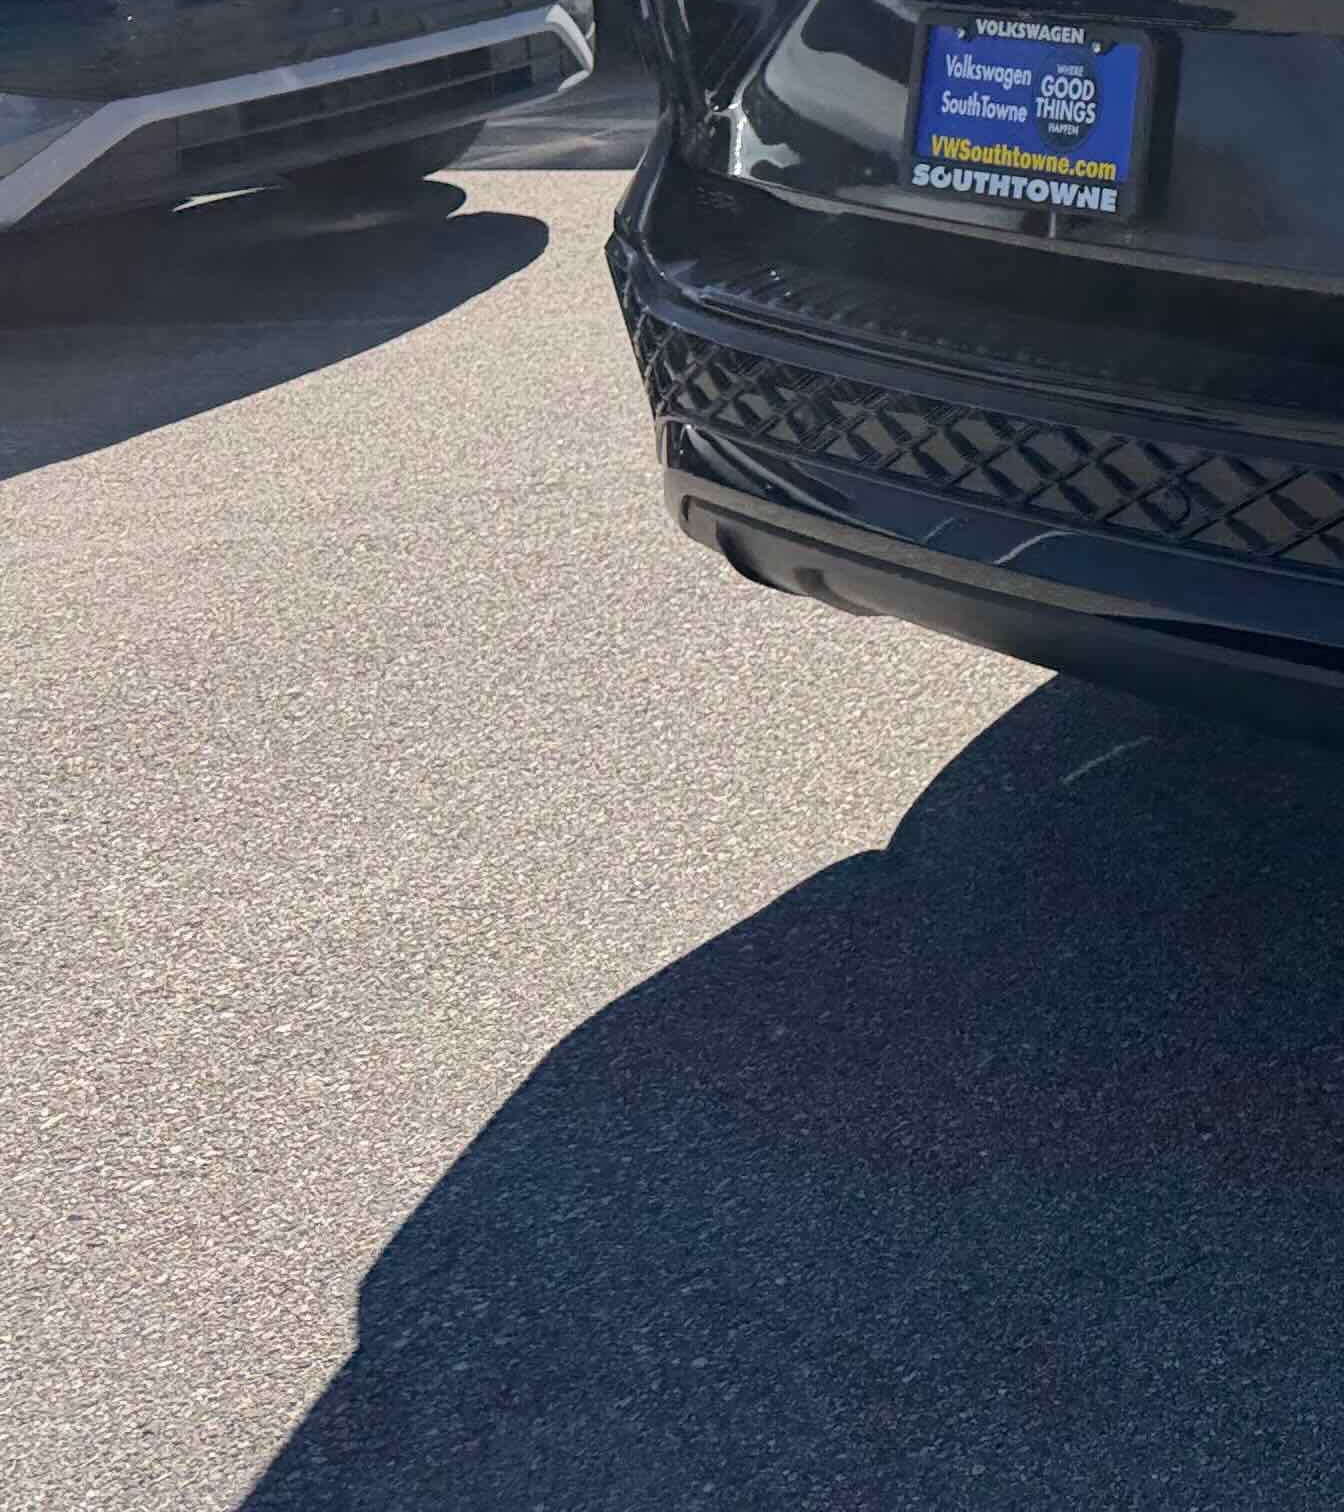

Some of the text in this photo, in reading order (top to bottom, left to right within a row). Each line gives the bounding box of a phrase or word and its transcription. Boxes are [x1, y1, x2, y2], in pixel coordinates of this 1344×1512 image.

[976, 19, 1085, 45] VOLKSWAGEN
[945, 54, 1032, 90] Volkswagen
[1041, 74, 1095, 101] GOOD
[941, 91, 1028, 123] SouthTowne
[1035, 97, 1097, 124] THINGS
[930, 134, 1116, 181] VWSouthtowne.com
[911, 163, 1118, 213] SOUTHTOWNE
